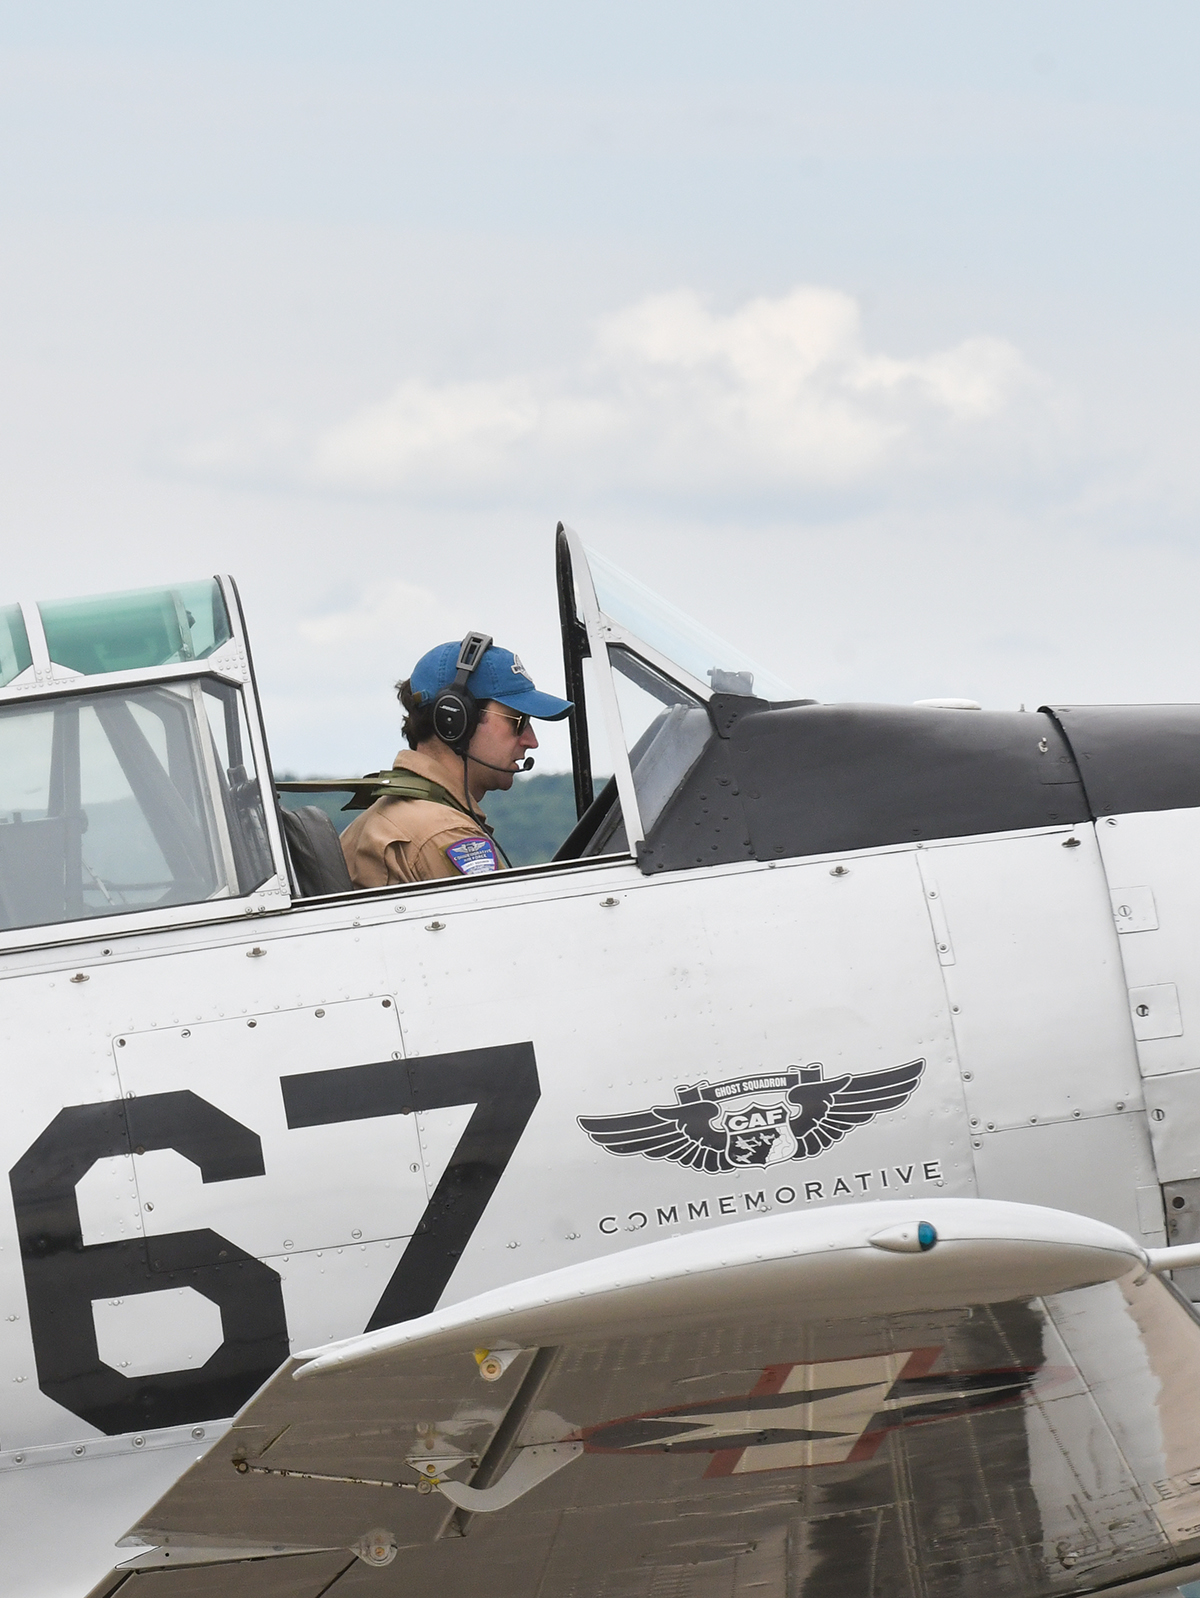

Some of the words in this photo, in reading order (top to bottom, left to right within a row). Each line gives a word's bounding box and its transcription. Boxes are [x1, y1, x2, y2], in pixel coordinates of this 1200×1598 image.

[714, 1083, 741, 1098] GHOST
[742, 1076, 787, 1091] SQUADRON
[728, 1109, 783, 1131] CAF
[599, 1162, 941, 1234] COMMEMORATIVE
